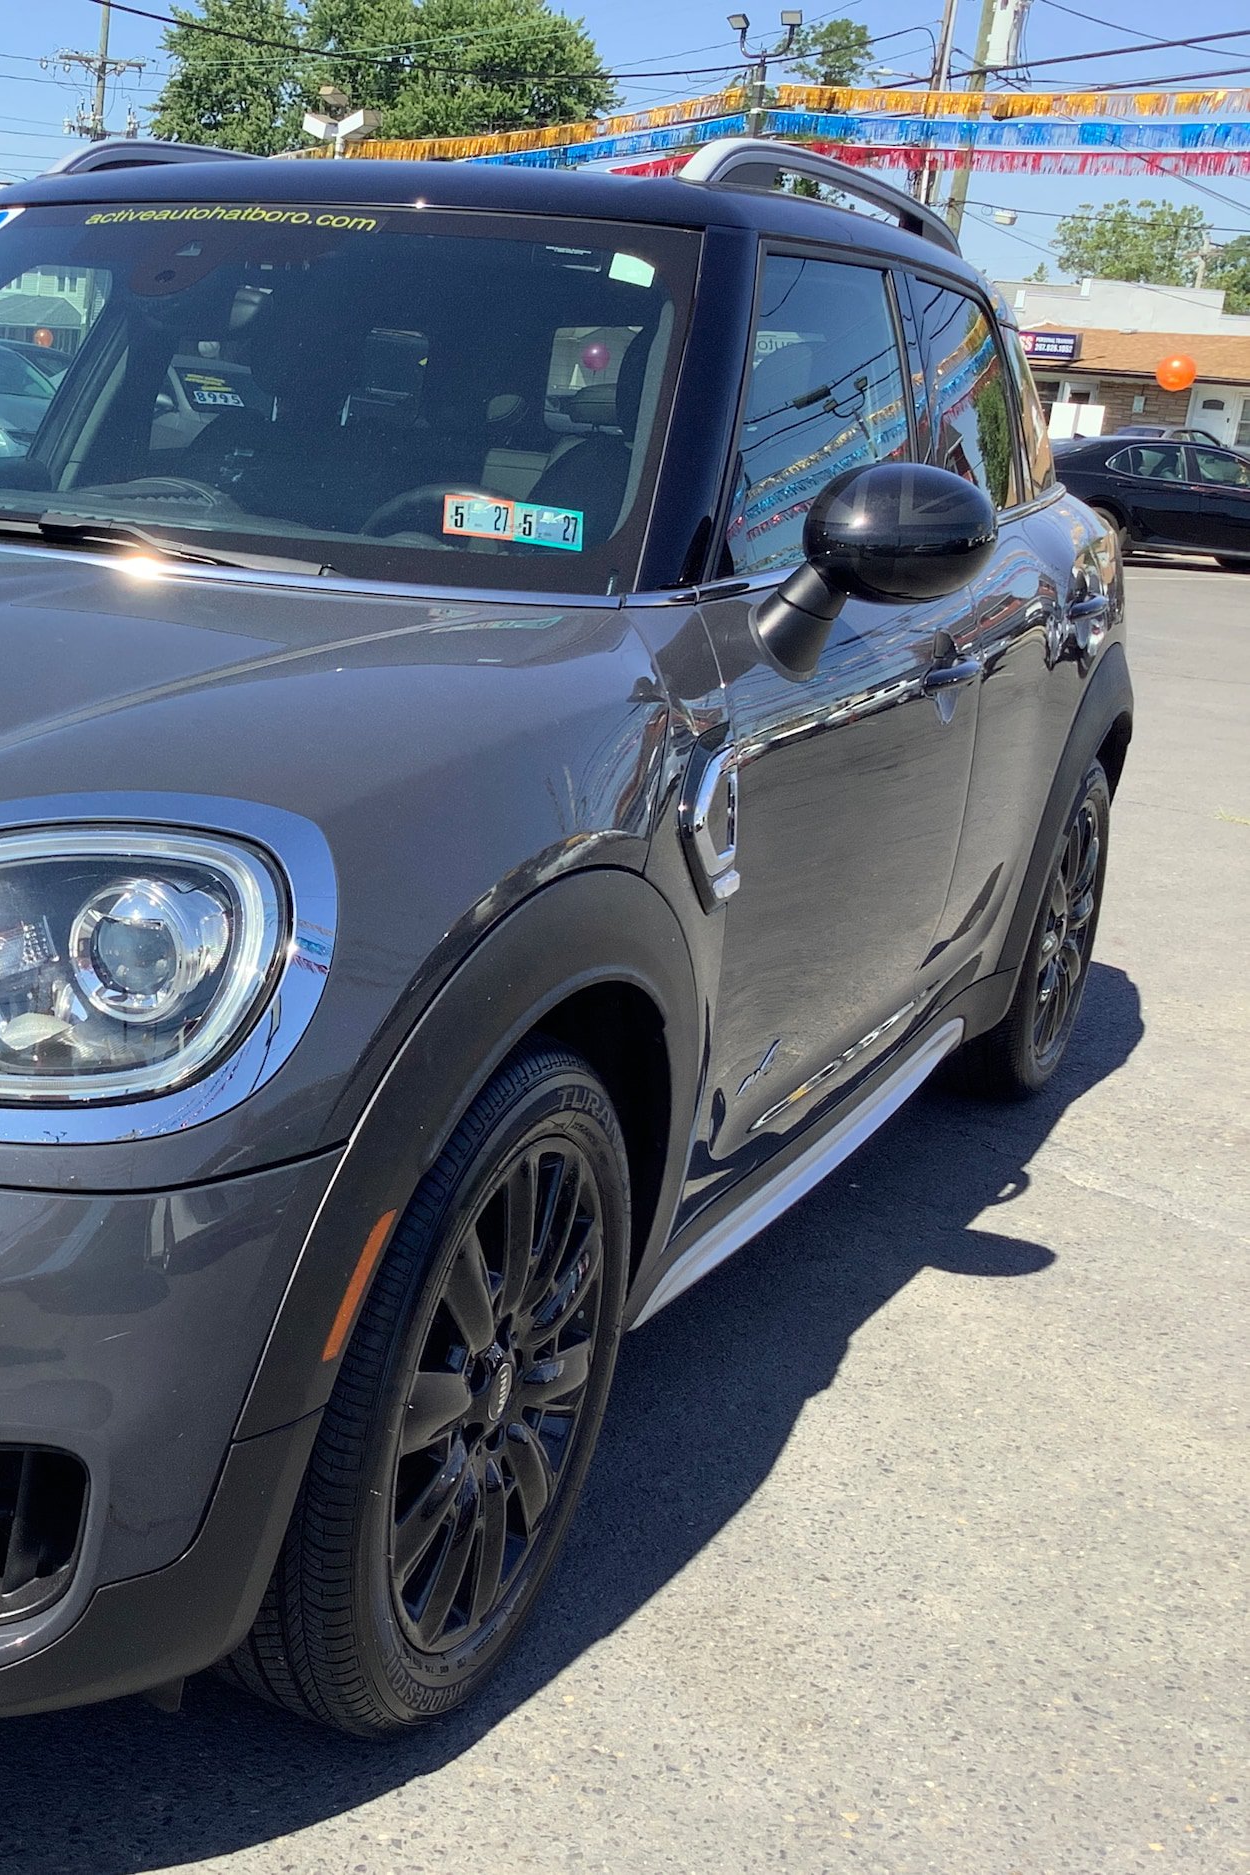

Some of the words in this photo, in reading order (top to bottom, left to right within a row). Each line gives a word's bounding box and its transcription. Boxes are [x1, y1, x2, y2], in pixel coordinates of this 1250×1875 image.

[84, 205, 378, 232] activeautohatboro.com
[196, 391, 241, 404] 8995
[454, 506, 465, 528] 5
[494, 506, 509, 534] 27
[522, 514, 533, 536] 5
[563, 515, 579, 543] 27
[497, 1372, 508, 1413] MINI
